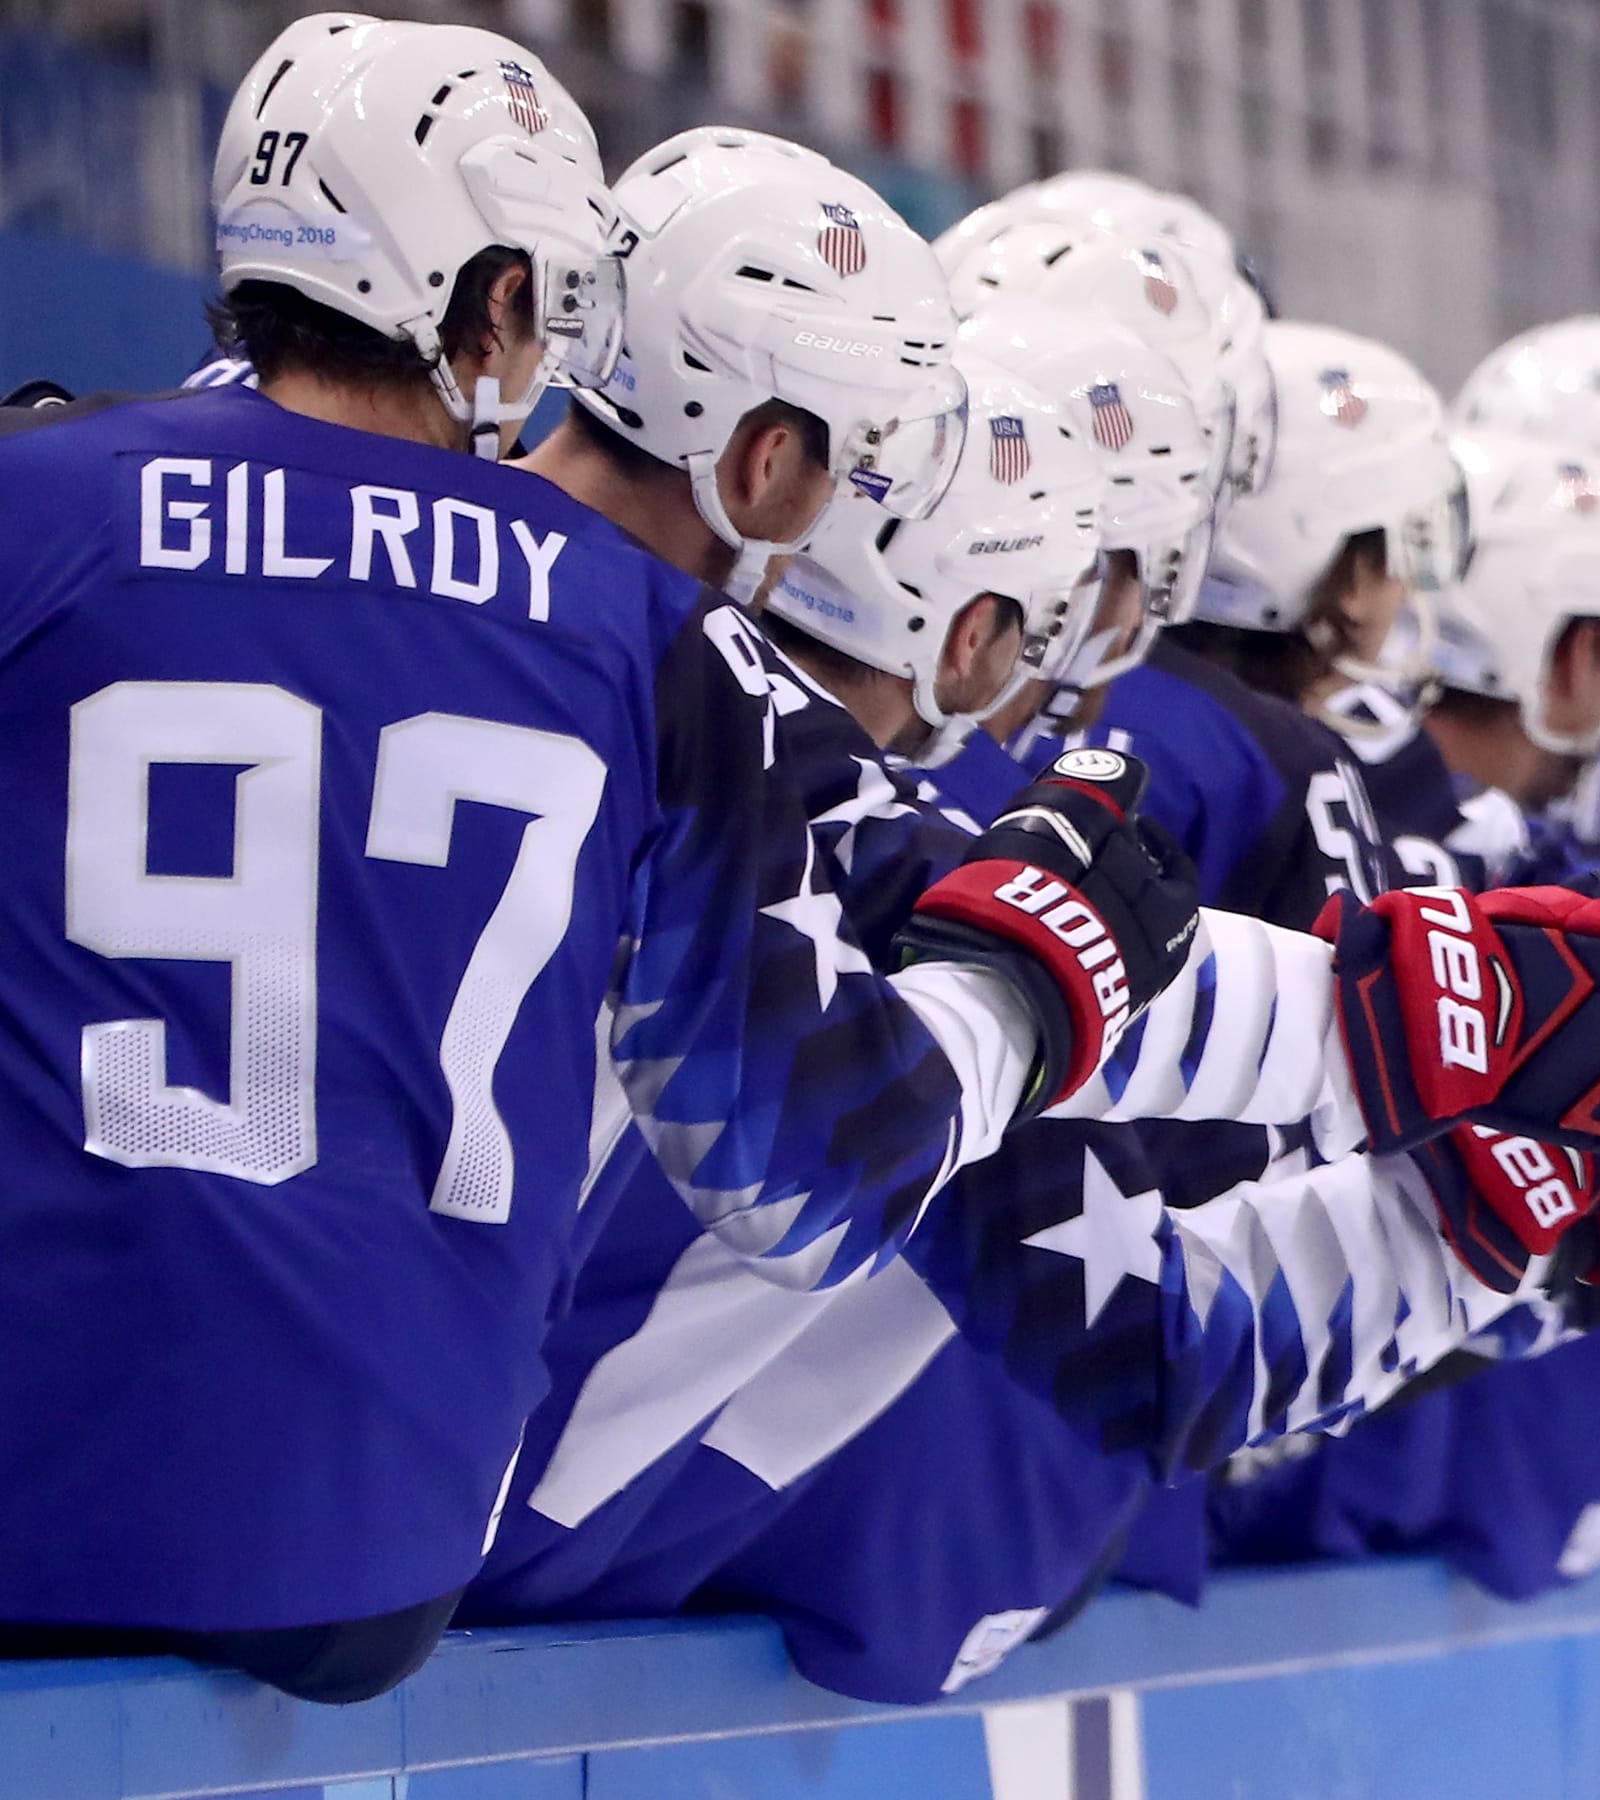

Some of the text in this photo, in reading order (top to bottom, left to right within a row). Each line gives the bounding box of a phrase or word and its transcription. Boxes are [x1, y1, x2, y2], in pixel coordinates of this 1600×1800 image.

[250, 131, 309, 186] 97
[297, 226, 336, 245] 2018
[993, 418, 1021, 436] USA
[140, 457, 568, 623] GILROY
[64, 680, 608, 1225] 97
